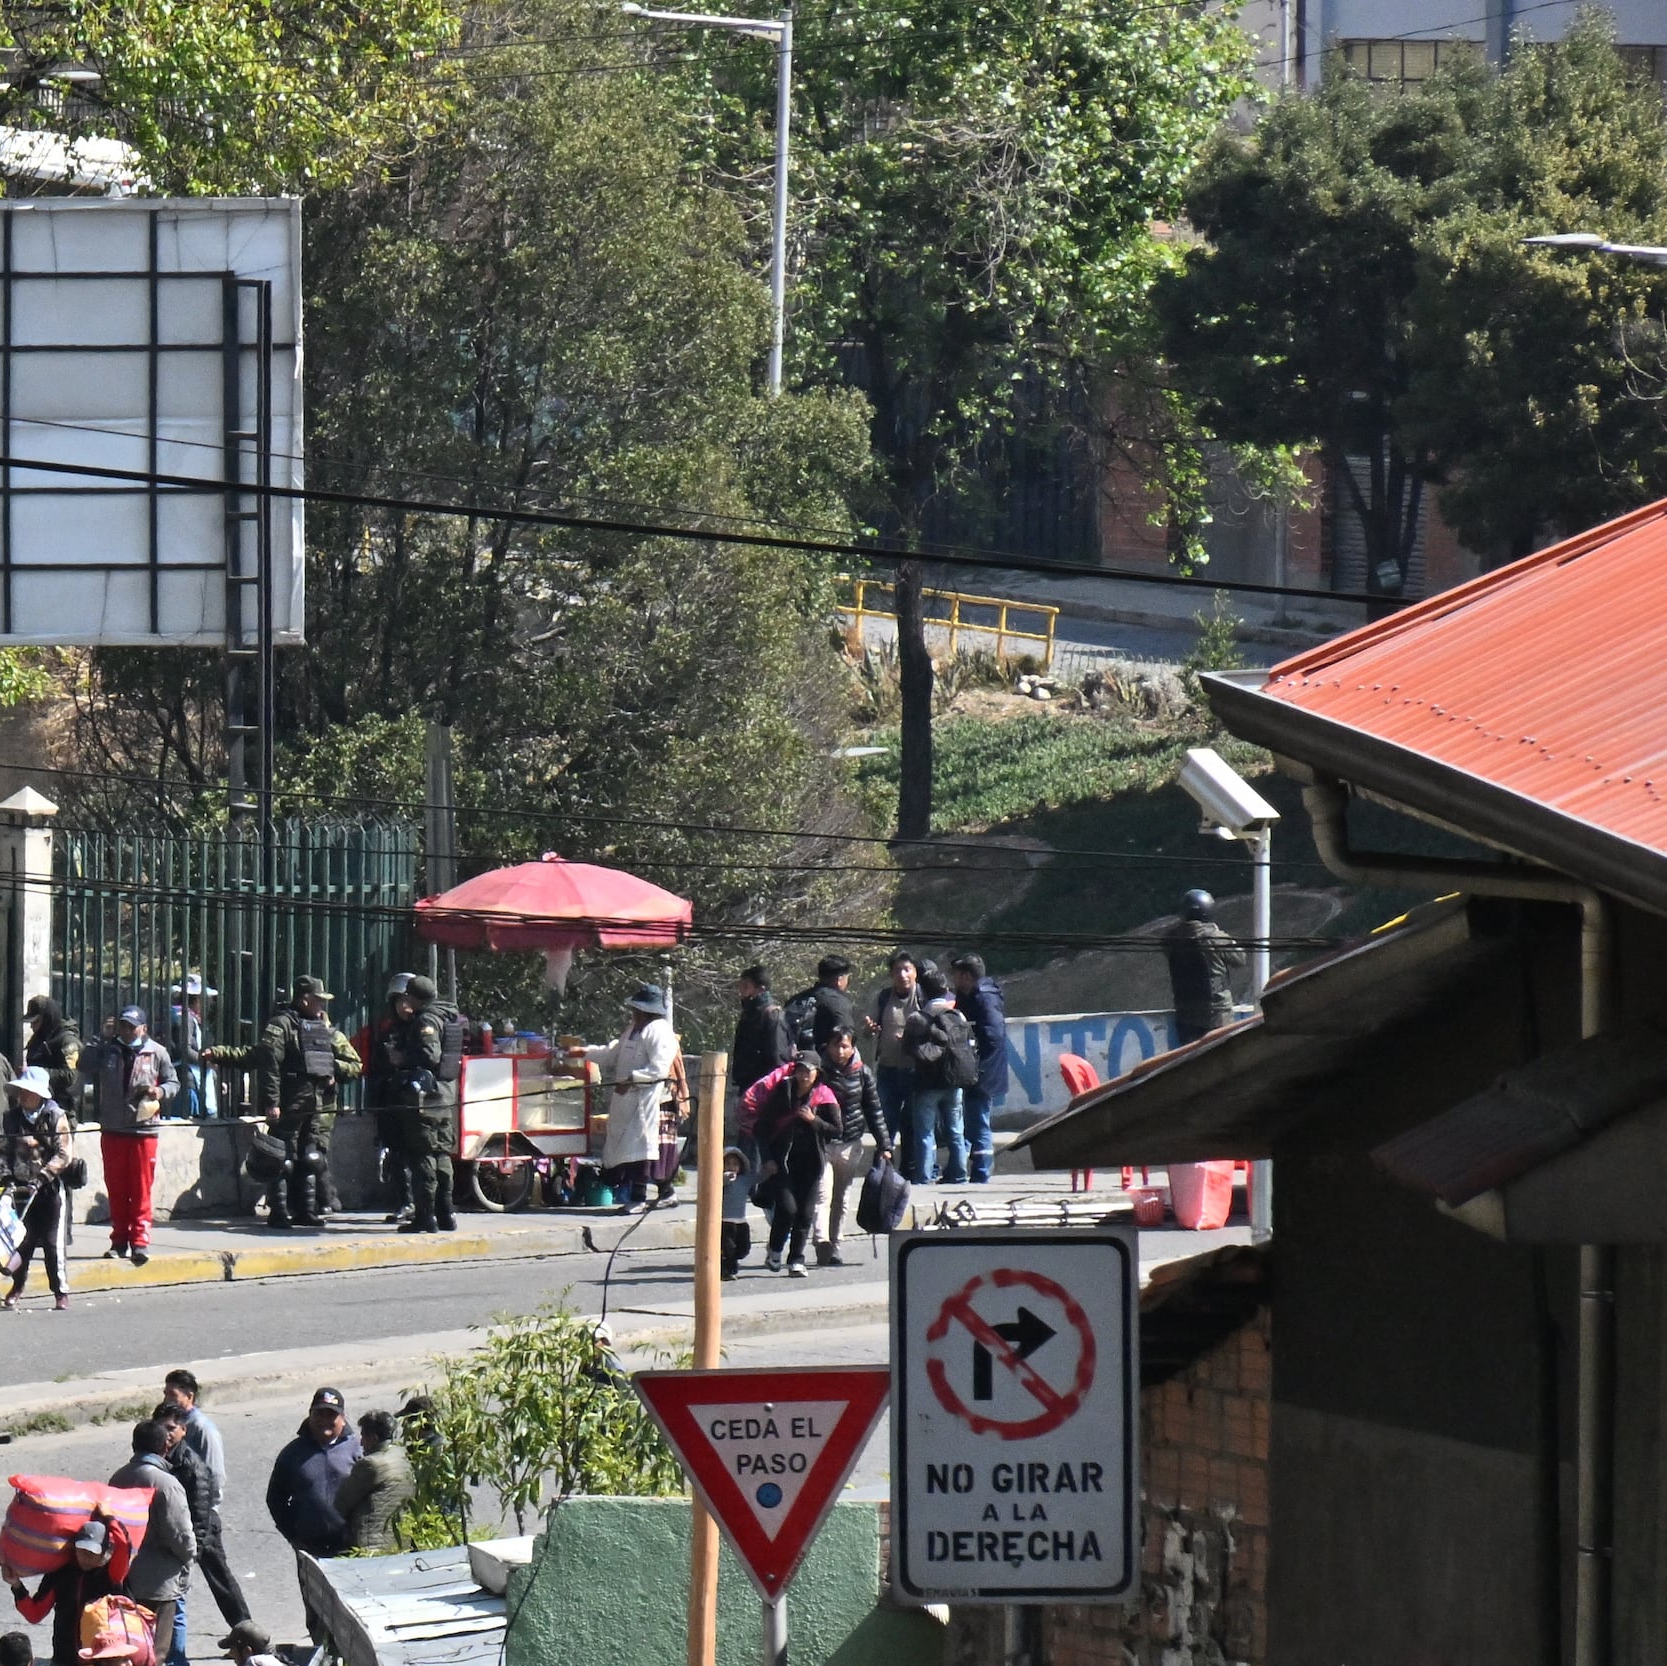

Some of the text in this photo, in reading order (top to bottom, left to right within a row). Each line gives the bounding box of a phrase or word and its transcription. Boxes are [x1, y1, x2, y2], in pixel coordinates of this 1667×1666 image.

[710, 1416, 823, 1441] CEDA EL
[736, 1451, 808, 1476] PASO
[926, 1461, 1104, 1495] NO GIRAR
[981, 1501, 1048, 1523] A LA
[926, 1530, 1103, 1562] DERECHA
